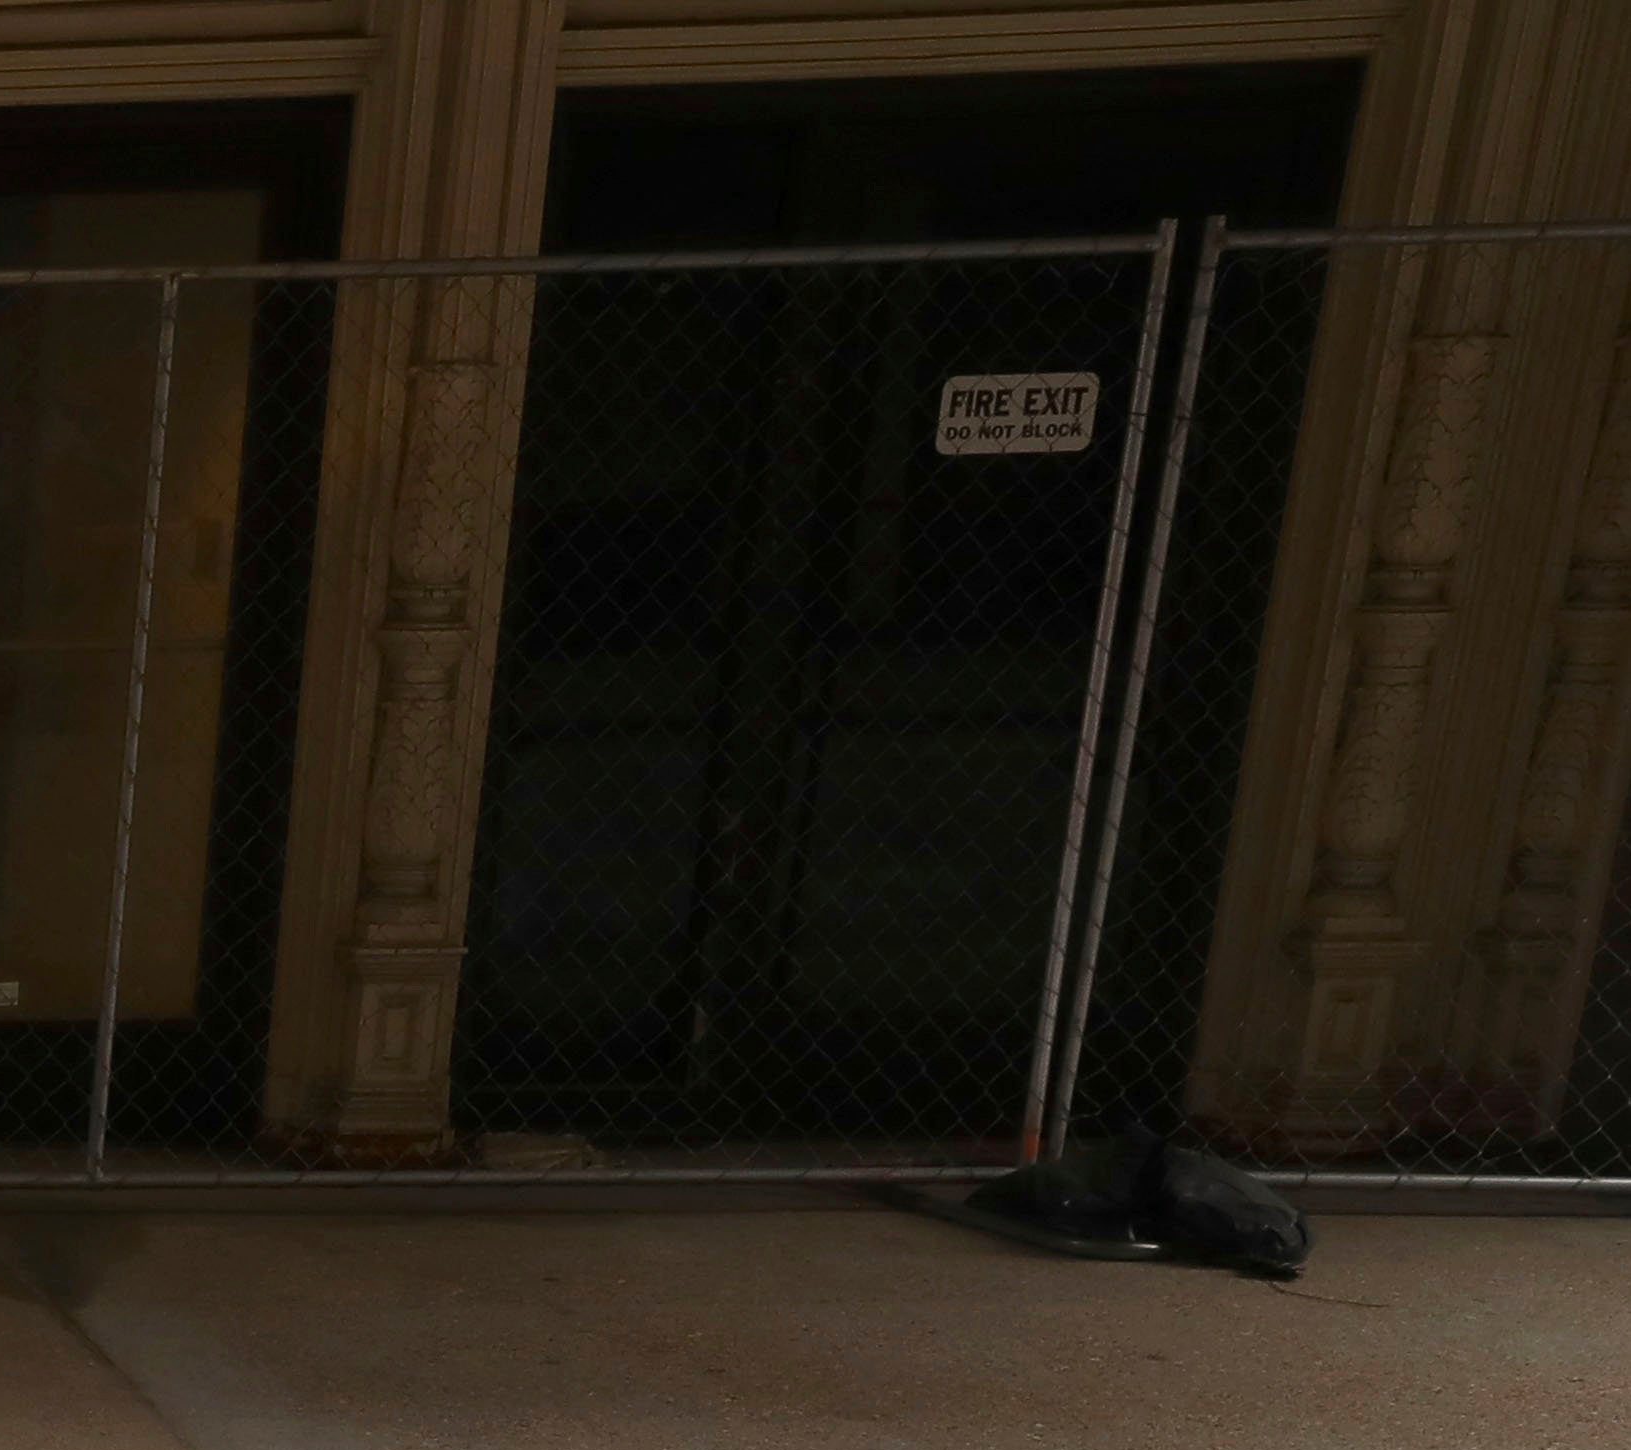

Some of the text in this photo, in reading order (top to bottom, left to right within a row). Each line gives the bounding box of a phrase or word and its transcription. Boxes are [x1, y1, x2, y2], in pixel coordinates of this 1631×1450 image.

[948, 386, 1088, 418] FIRE EXIT
[945, 421, 1083, 440] DO NOT BLOCK
